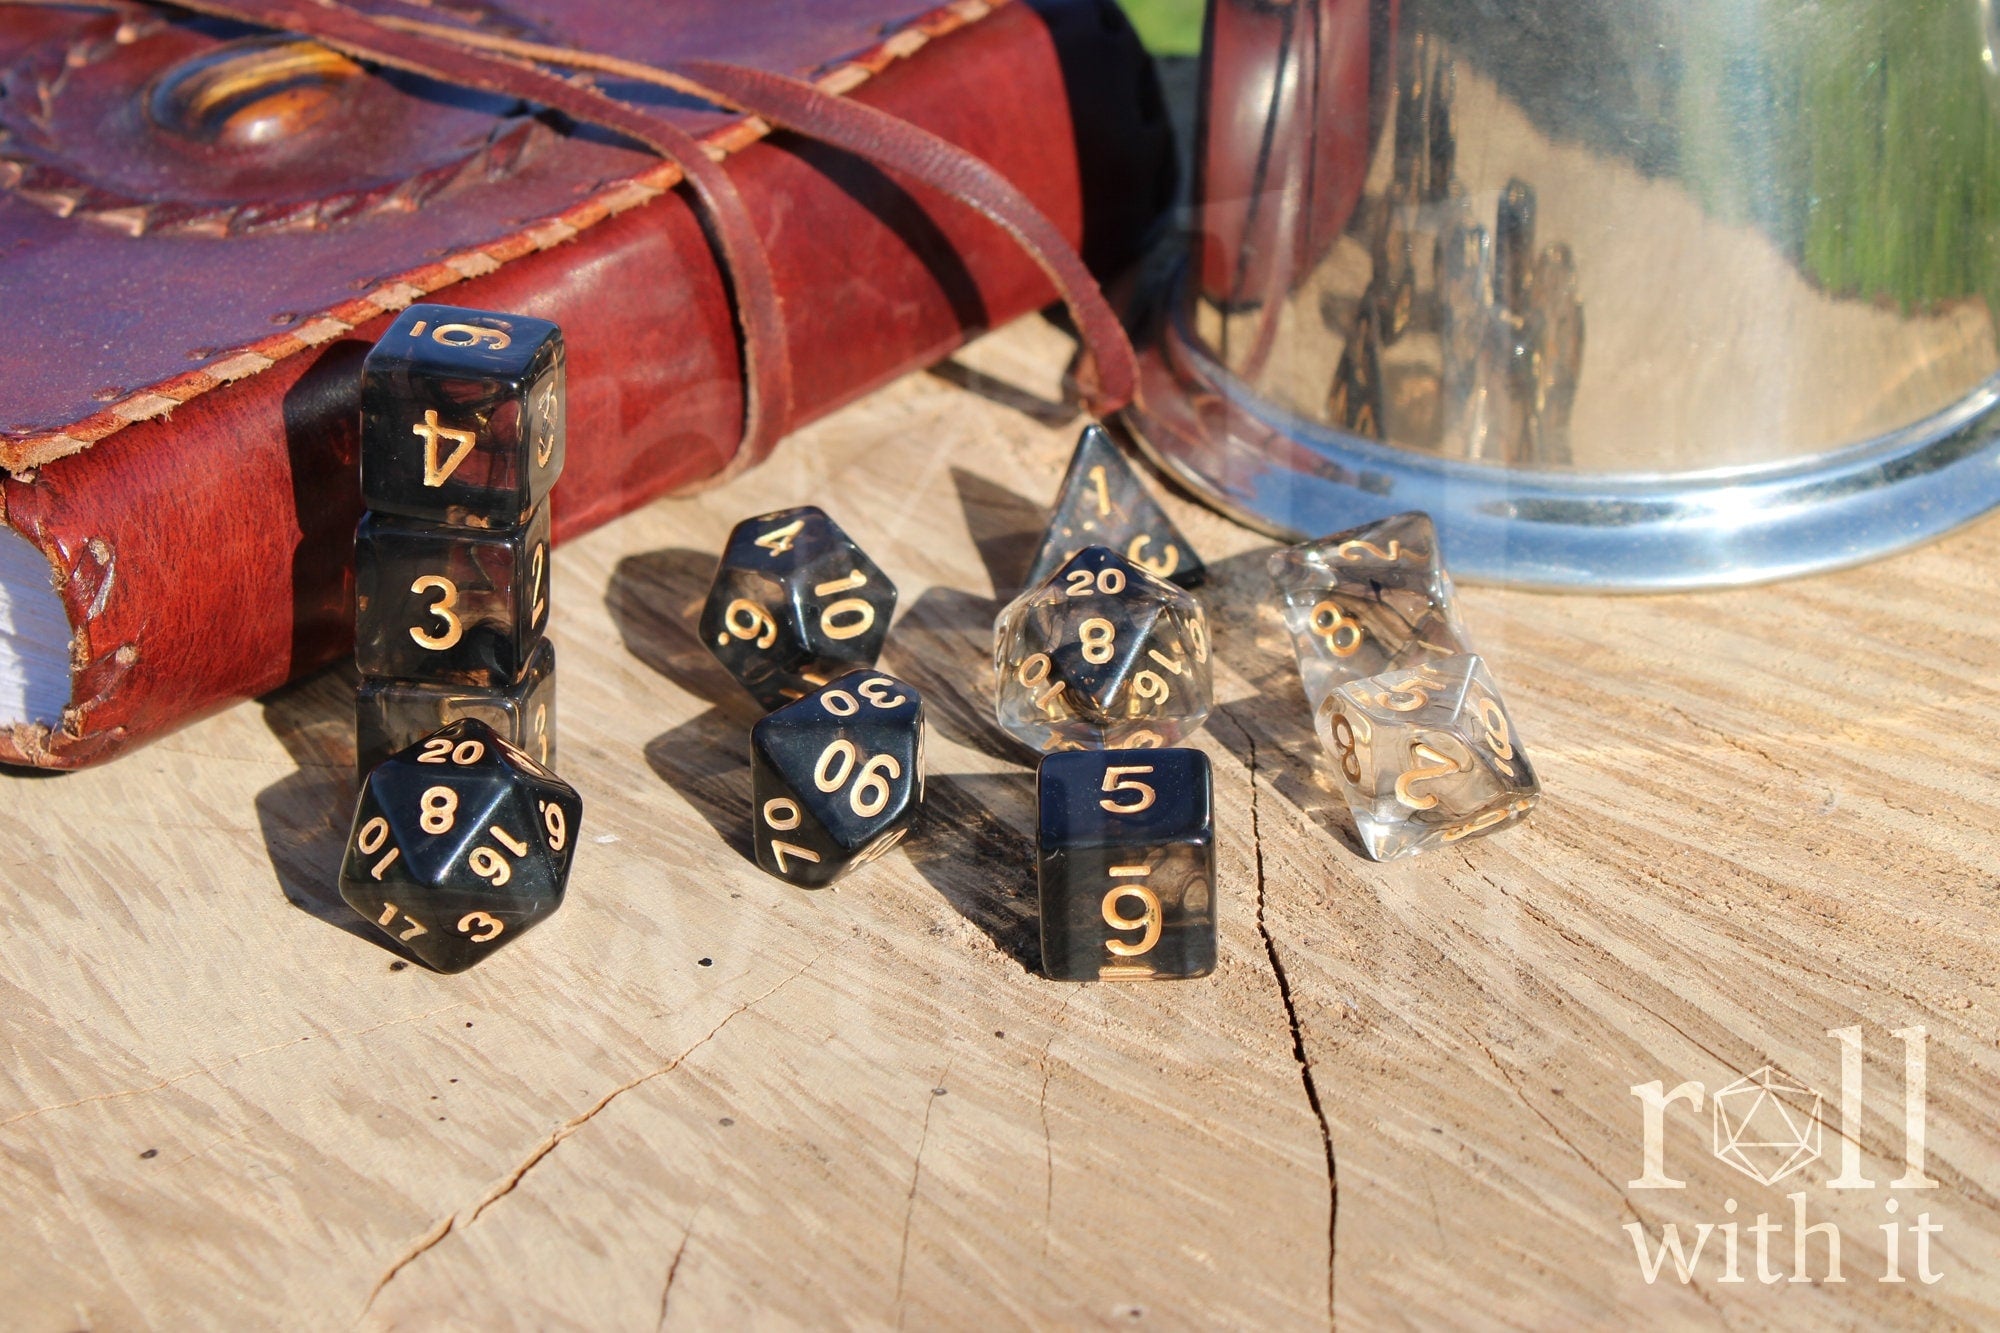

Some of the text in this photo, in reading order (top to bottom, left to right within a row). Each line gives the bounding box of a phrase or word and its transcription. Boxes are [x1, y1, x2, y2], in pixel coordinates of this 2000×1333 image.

[412, 409, 475, 487] 4
[1089, 465, 1111, 515] 1
[754, 520, 805, 557] 4
[1127, 534, 1179, 579] 3
[531, 542, 544, 630] 2
[814, 569, 875, 640] 10
[1065, 568, 1127, 597] 20
[409, 575, 463, 651] 3
[1309, 601, 1362, 657] 8
[1078, 618, 1116, 665] 8
[820, 677, 906, 717] 30
[1018, 652, 1066, 713] 10
[1132, 649, 1183, 706] 16
[1374, 676, 1447, 712] 5
[417, 738, 485, 765] 20
[1330, 712, 1362, 785] 8
[1099, 765, 1156, 814] 5
[1394, 743, 1460, 810] 2
[419, 785, 459, 835] 8
[358, 816, 400, 881] 10
[468, 825, 528, 887] 16
[377, 901, 428, 942] 17
[457, 911, 504, 943] 3
